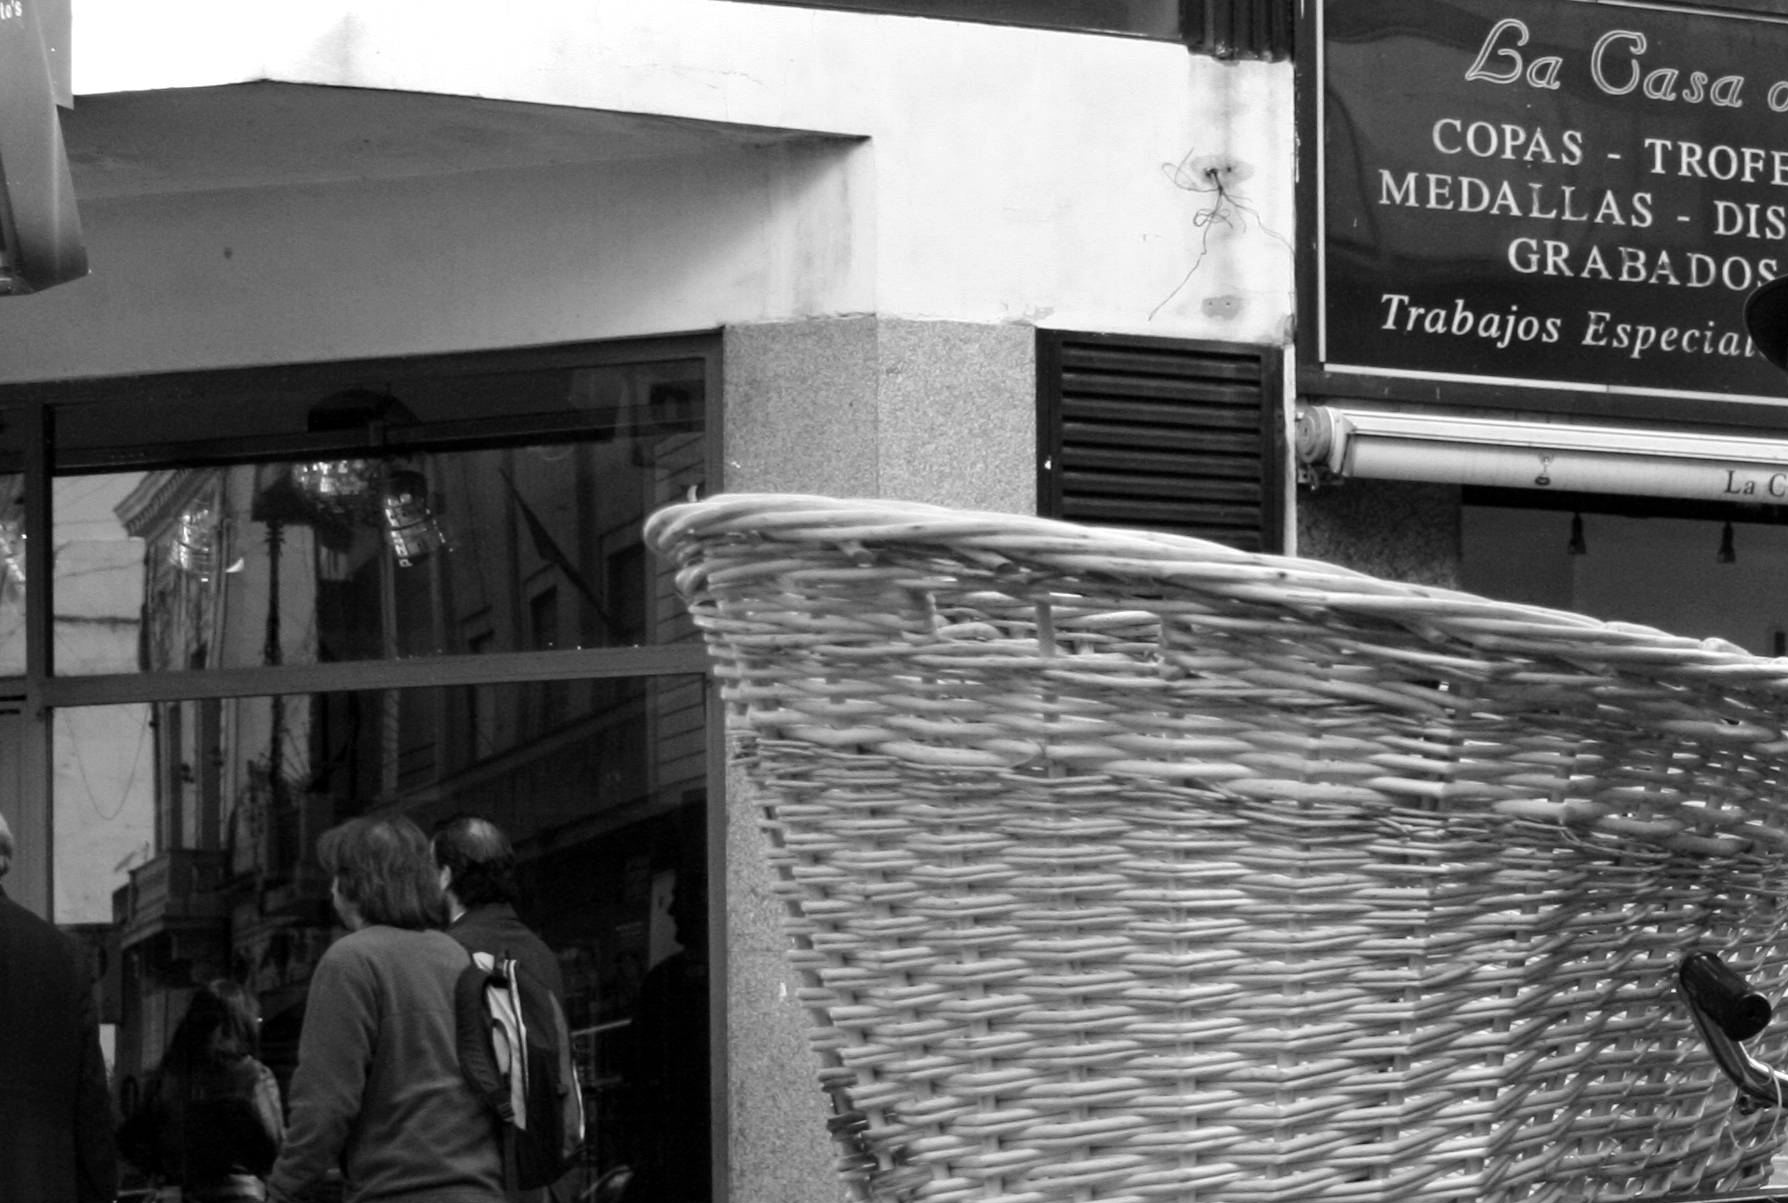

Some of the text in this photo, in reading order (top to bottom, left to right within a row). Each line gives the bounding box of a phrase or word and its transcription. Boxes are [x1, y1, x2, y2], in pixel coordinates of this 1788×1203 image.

[1465, 17, 1563, 90] La
[1591, 29, 1745, 107] Casa
[1432, 118, 1584, 166] COPAS
[1378, 169, 1654, 228] MEDALLAS
[1507, 238, 1778, 291] GRABADOS
[1380, 293, 1562, 349] Trabajos
[1723, 470, 1756, 496] La
